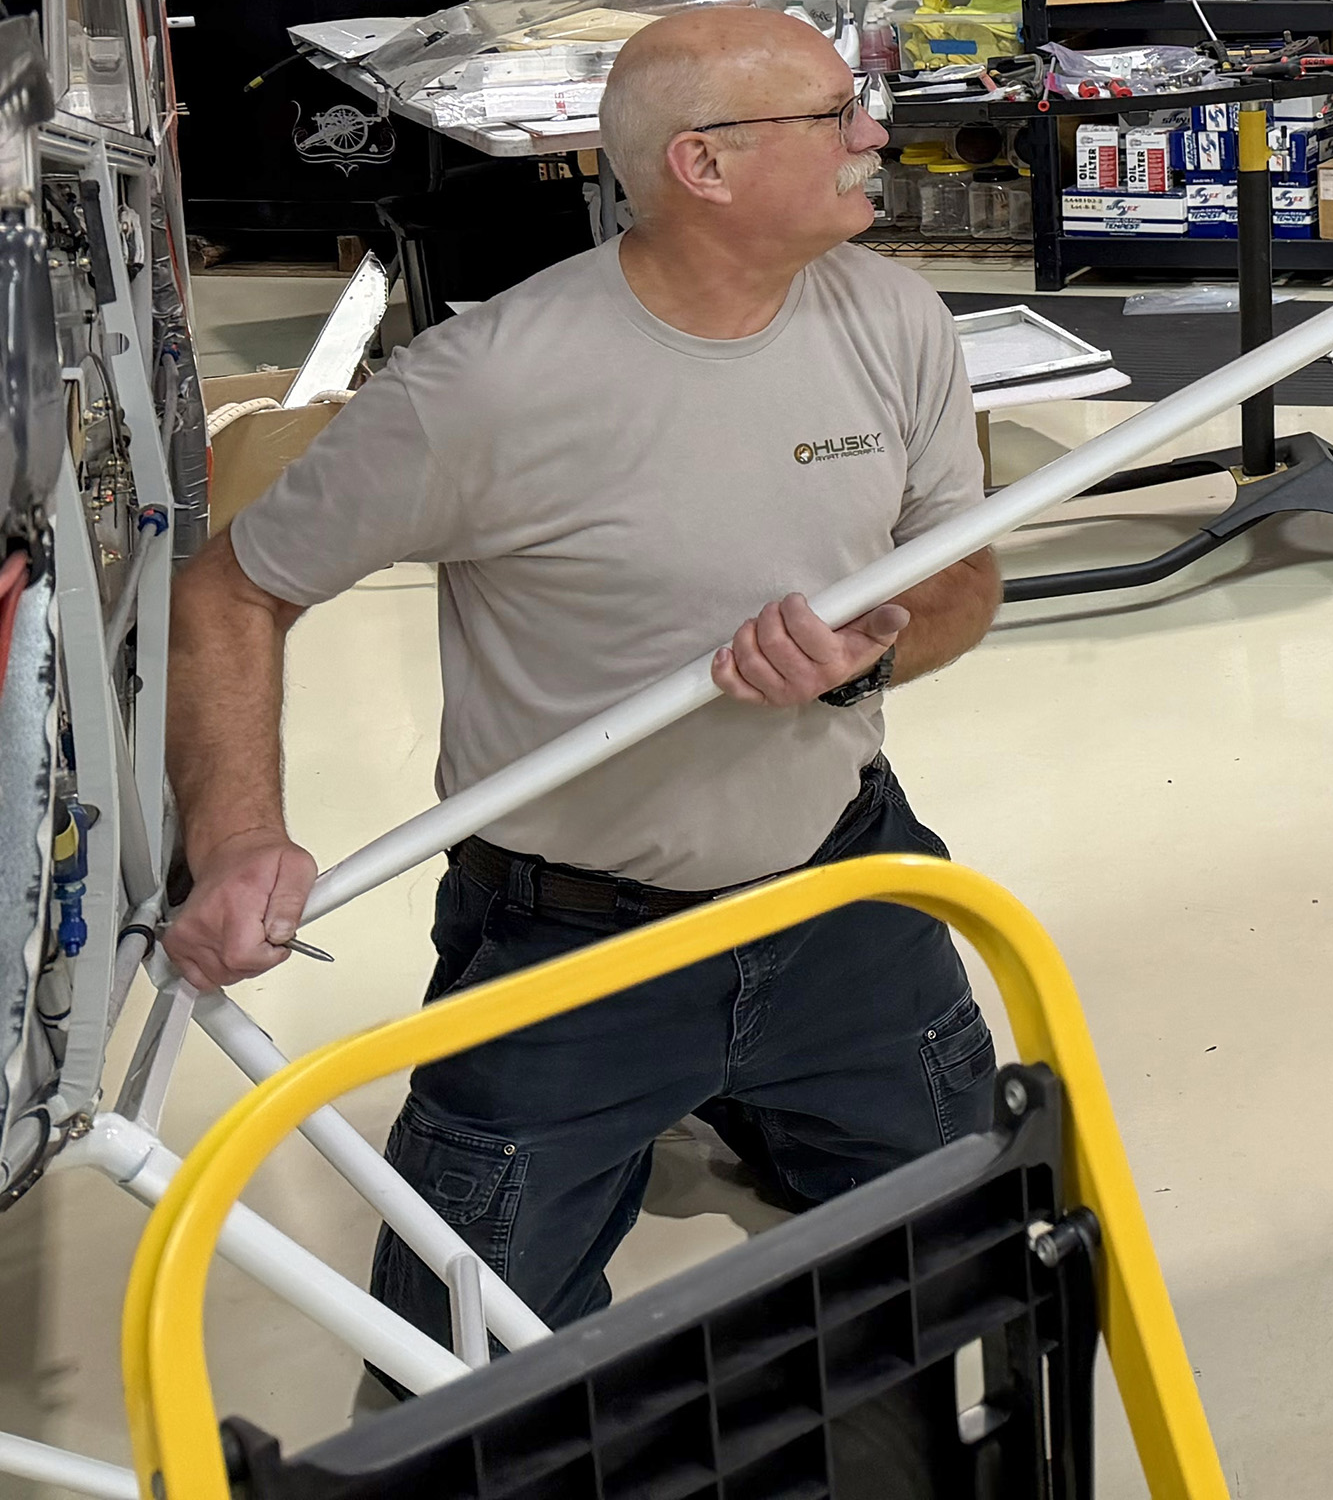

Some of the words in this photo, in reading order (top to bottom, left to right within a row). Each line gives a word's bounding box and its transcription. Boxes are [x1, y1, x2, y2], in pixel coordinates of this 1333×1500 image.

[1079, 162, 1088, 181] OIL
[1088, 148, 1097, 180] FILTER
[1128, 165, 1137, 183] OIL
[1137, 150, 1147, 183] FILTER
[813, 432, 882, 456] HUSKY
